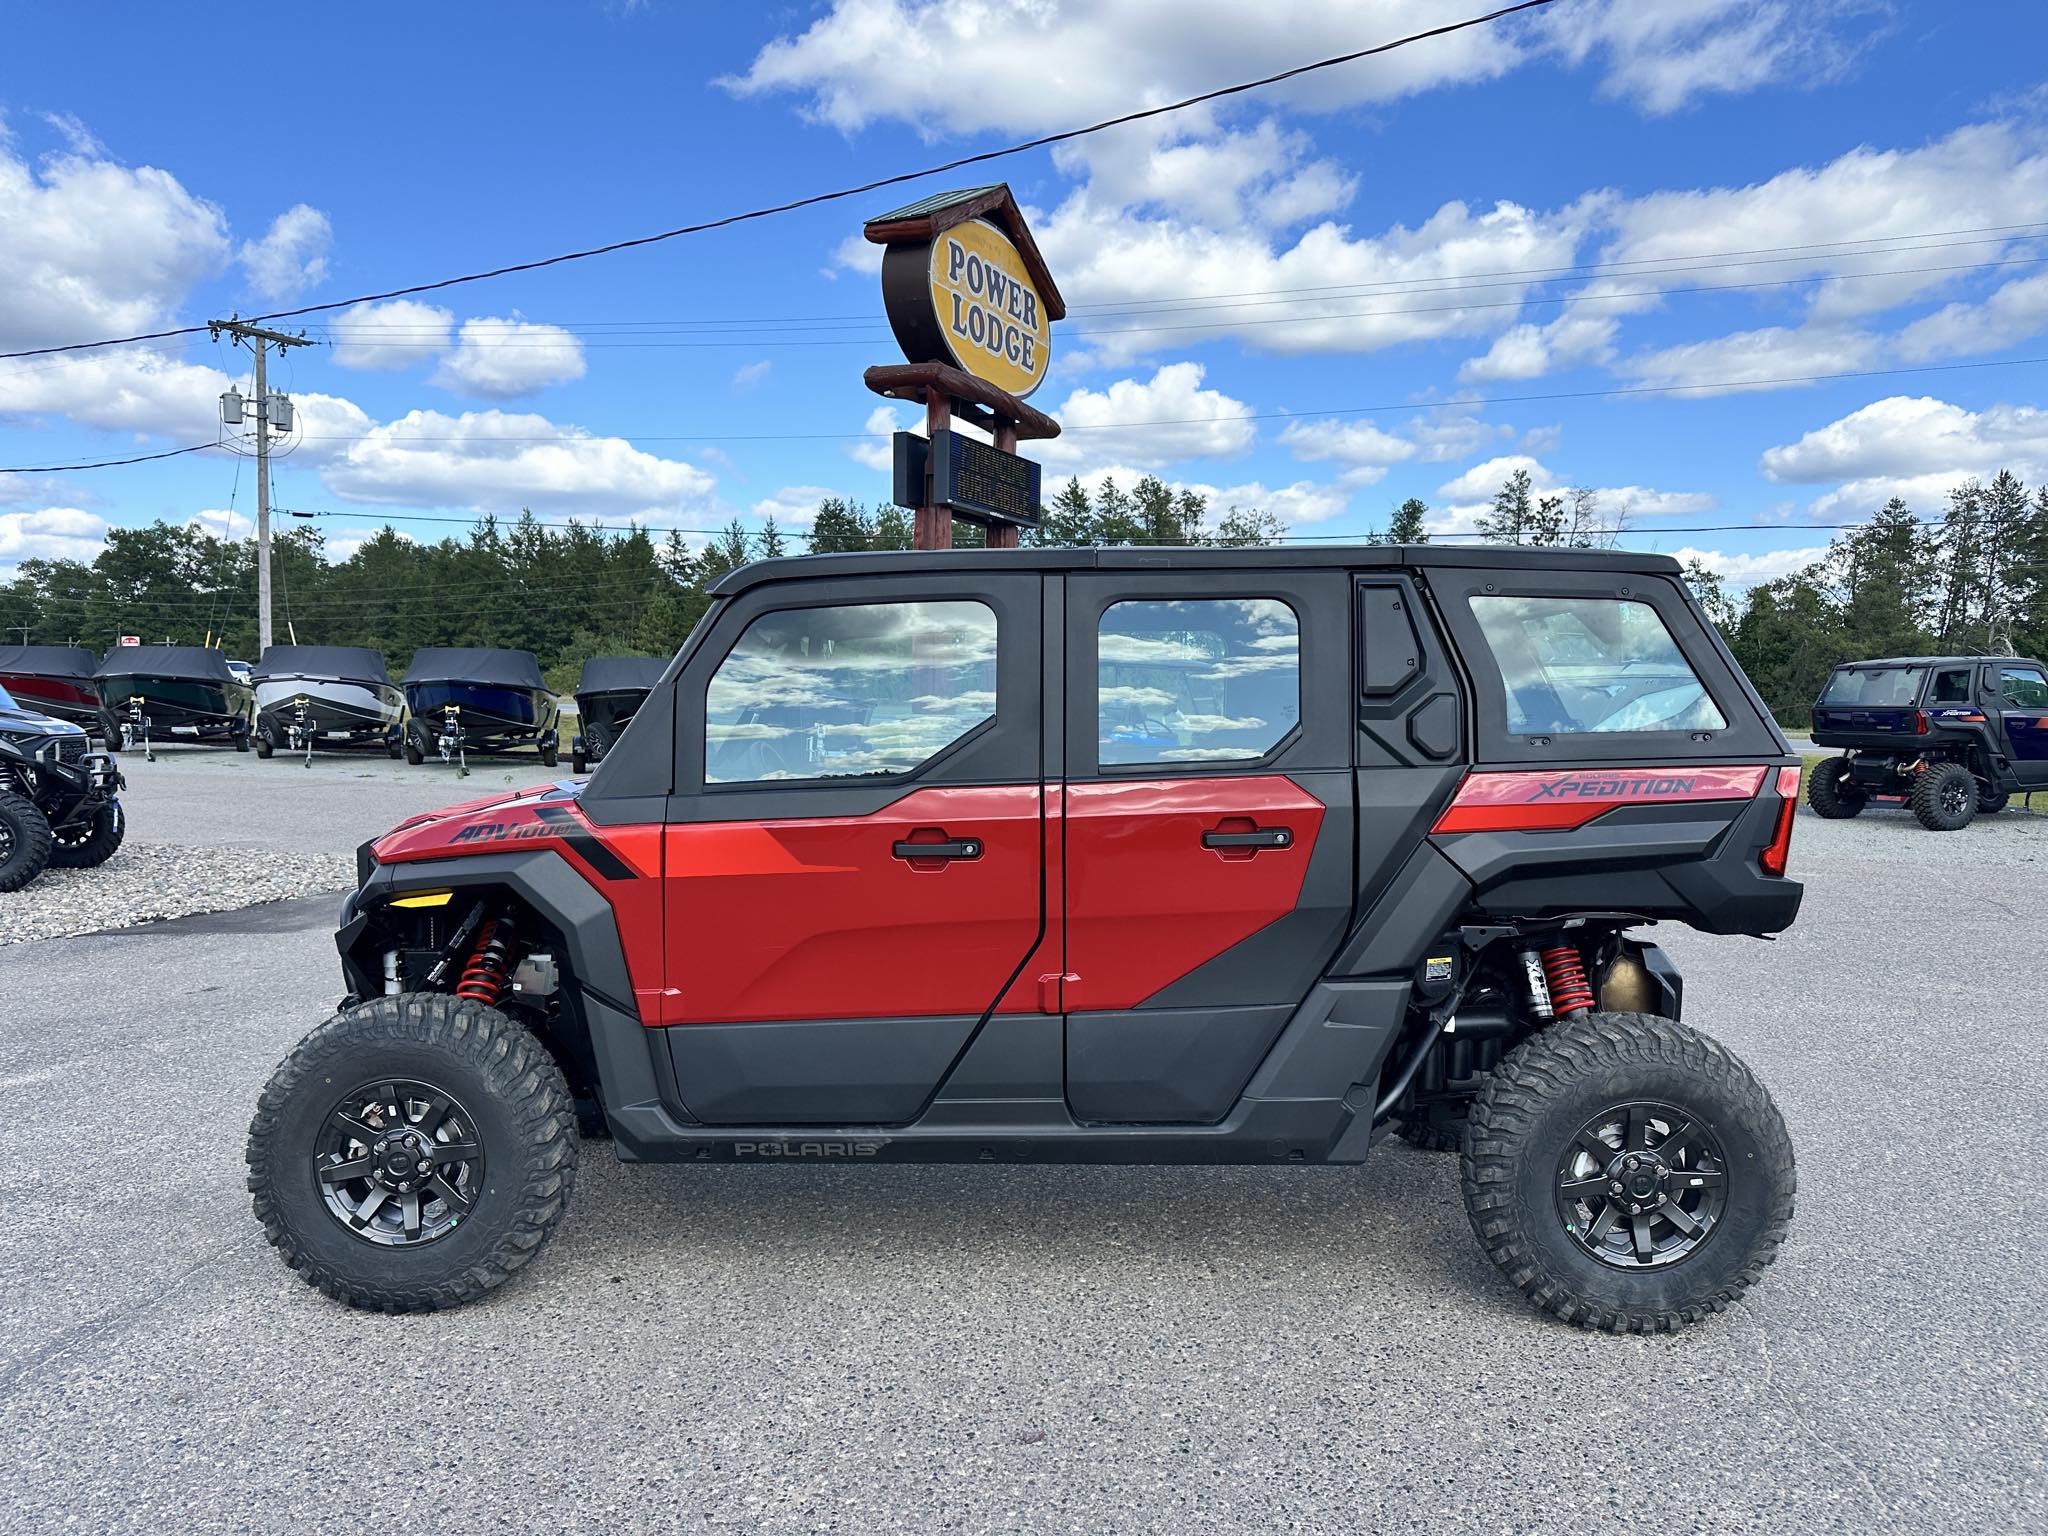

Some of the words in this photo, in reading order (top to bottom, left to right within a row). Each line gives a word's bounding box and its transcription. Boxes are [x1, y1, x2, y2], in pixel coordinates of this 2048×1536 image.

[949, 240, 1037, 330] POWER
[952, 293, 1035, 371] LODGE
[1526, 775, 1696, 802] XPEDITION
[734, 1142, 877, 1156] POLARIS
